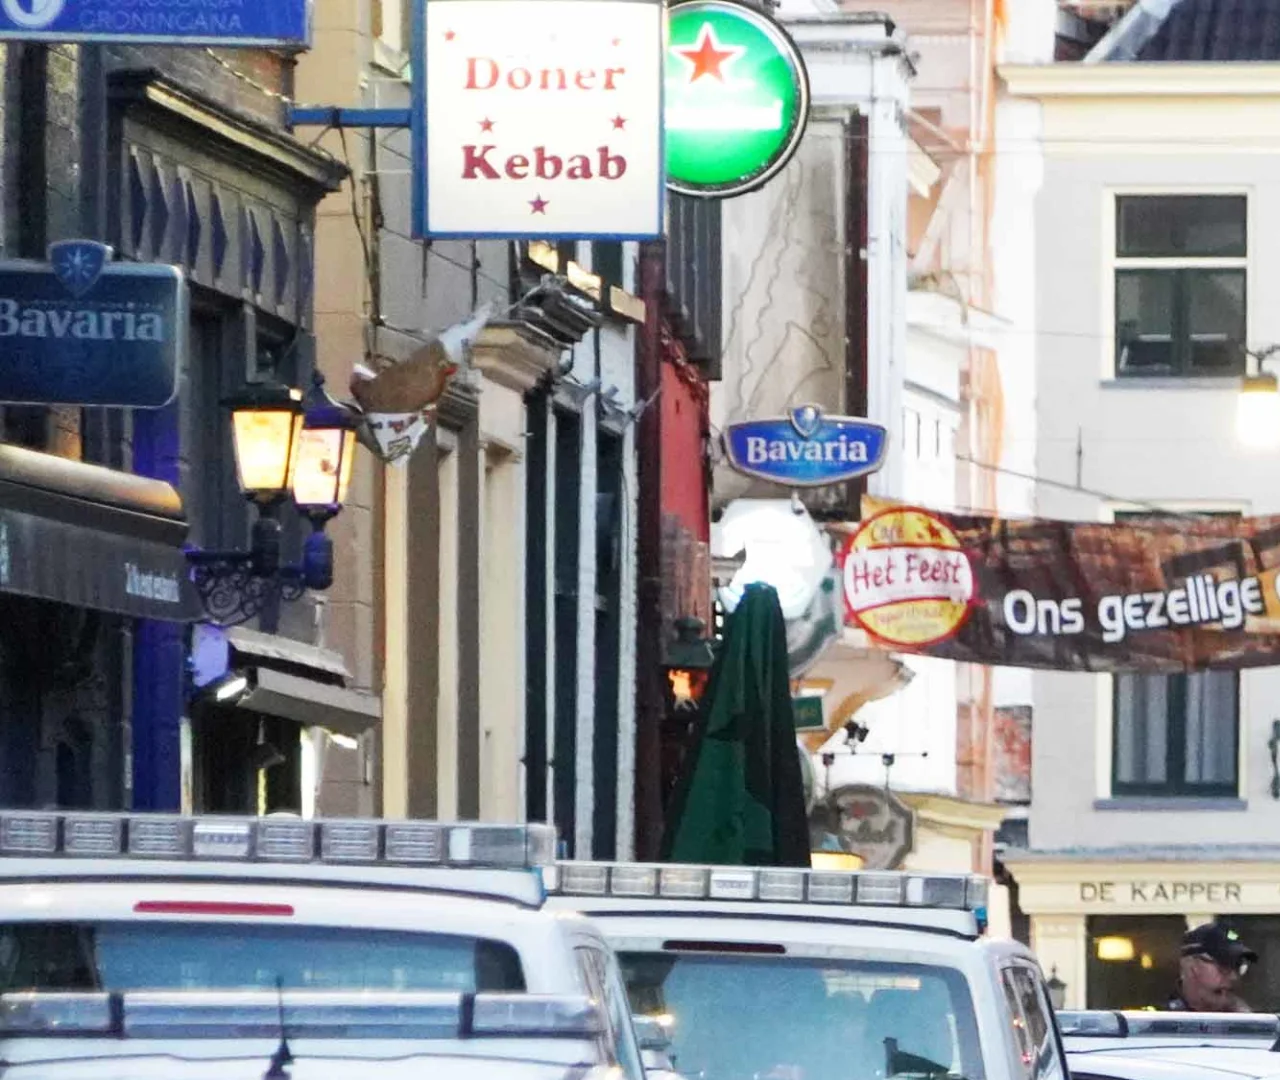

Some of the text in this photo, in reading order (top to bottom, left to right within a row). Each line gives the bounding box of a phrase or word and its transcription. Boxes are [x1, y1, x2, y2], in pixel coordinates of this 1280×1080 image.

[461, 145, 627, 180] Kebab
[747, 435, 867, 463] Bavaria
[853, 553, 963, 594] Het Feest
[1004, 589, 1084, 634] Ons
[1098, 574, 1262, 643] gezellige
[1080, 881, 1116, 901] DE
[1131, 881, 1242, 901] KAPPER
